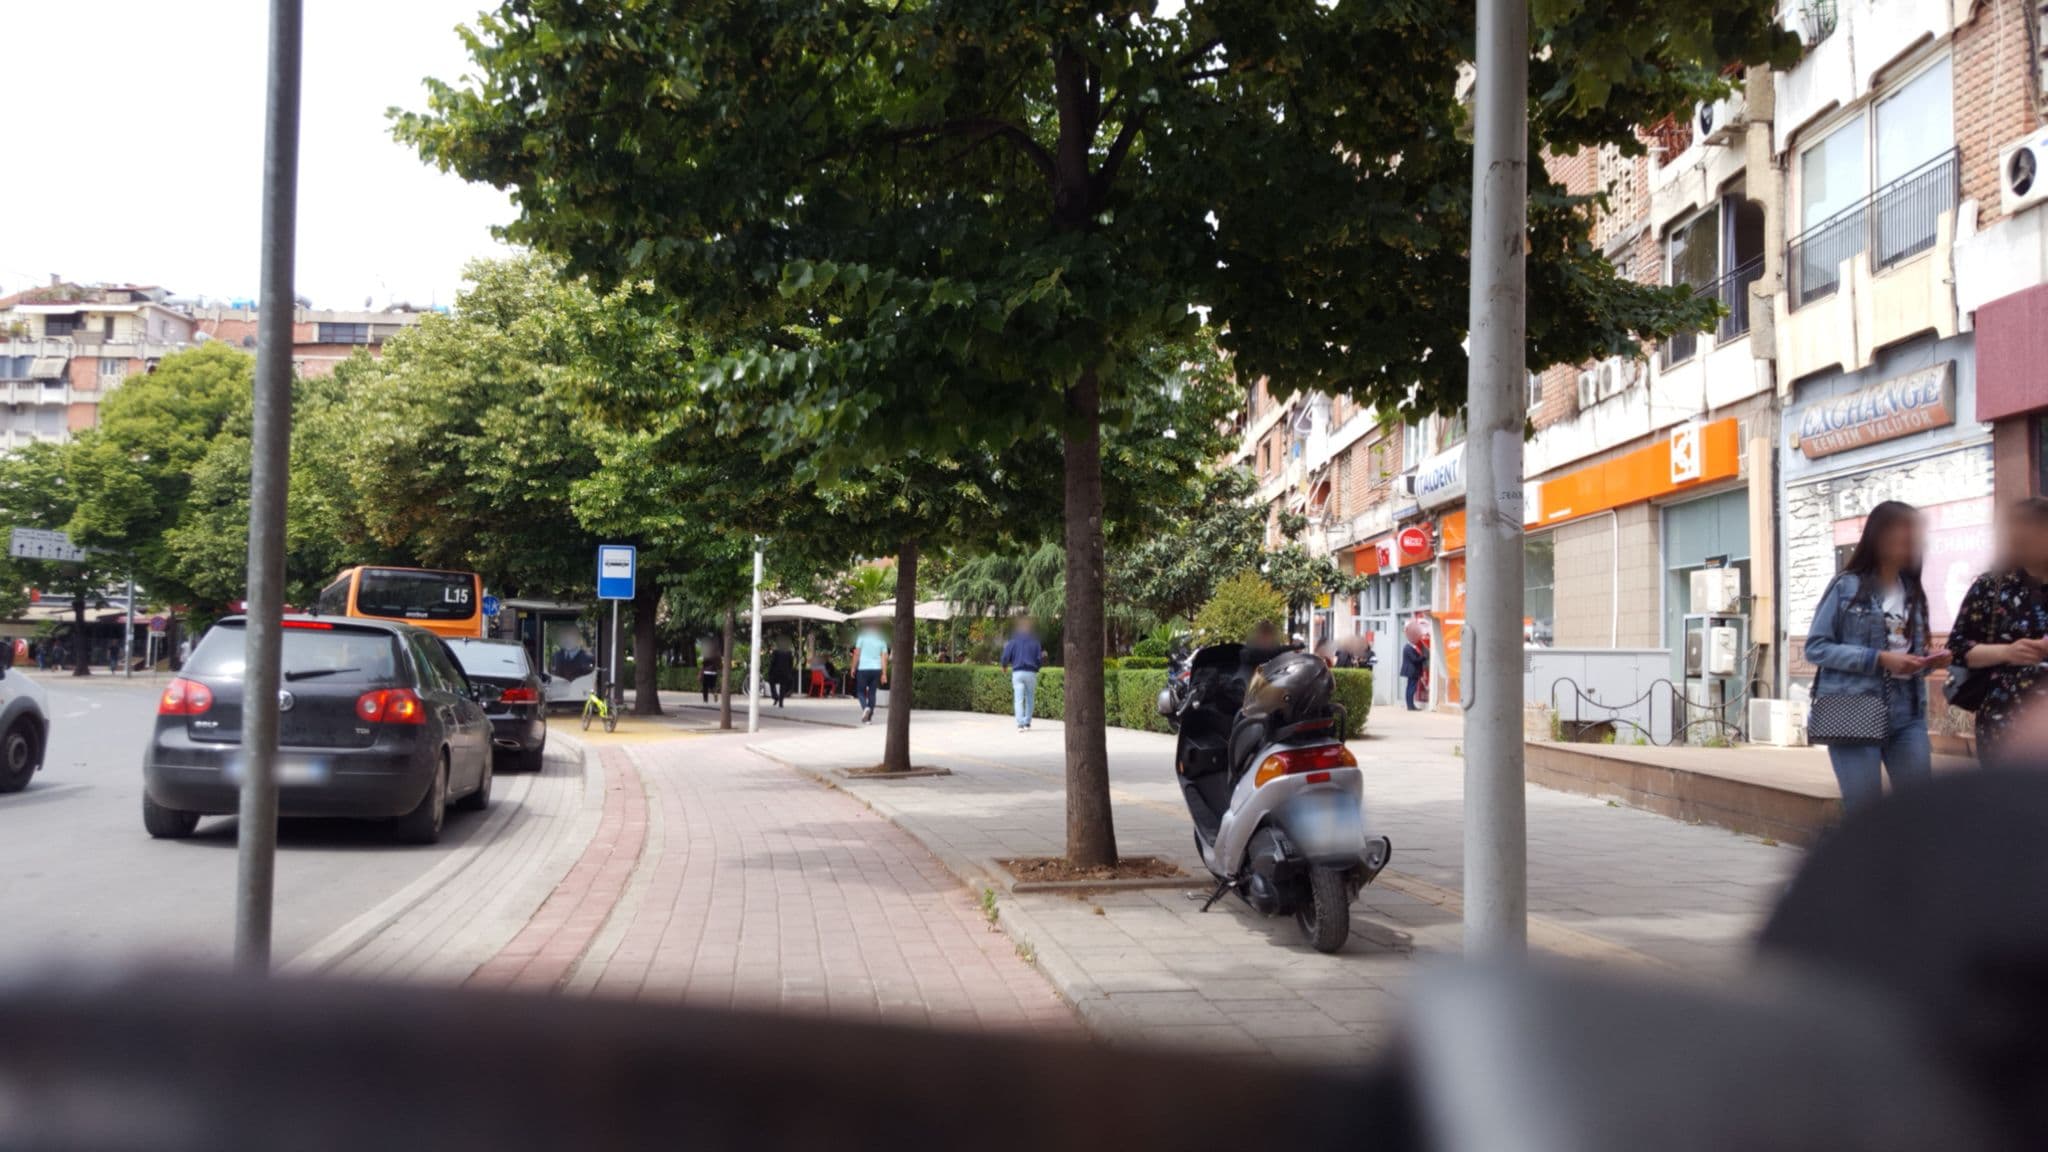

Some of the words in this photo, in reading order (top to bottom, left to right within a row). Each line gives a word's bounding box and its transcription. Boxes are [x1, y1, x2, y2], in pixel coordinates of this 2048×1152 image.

[1800, 372, 1943, 437] EXCHANGE
[1866, 410, 1932, 437] VALUTOR
[444, 587, 468, 603] L15
